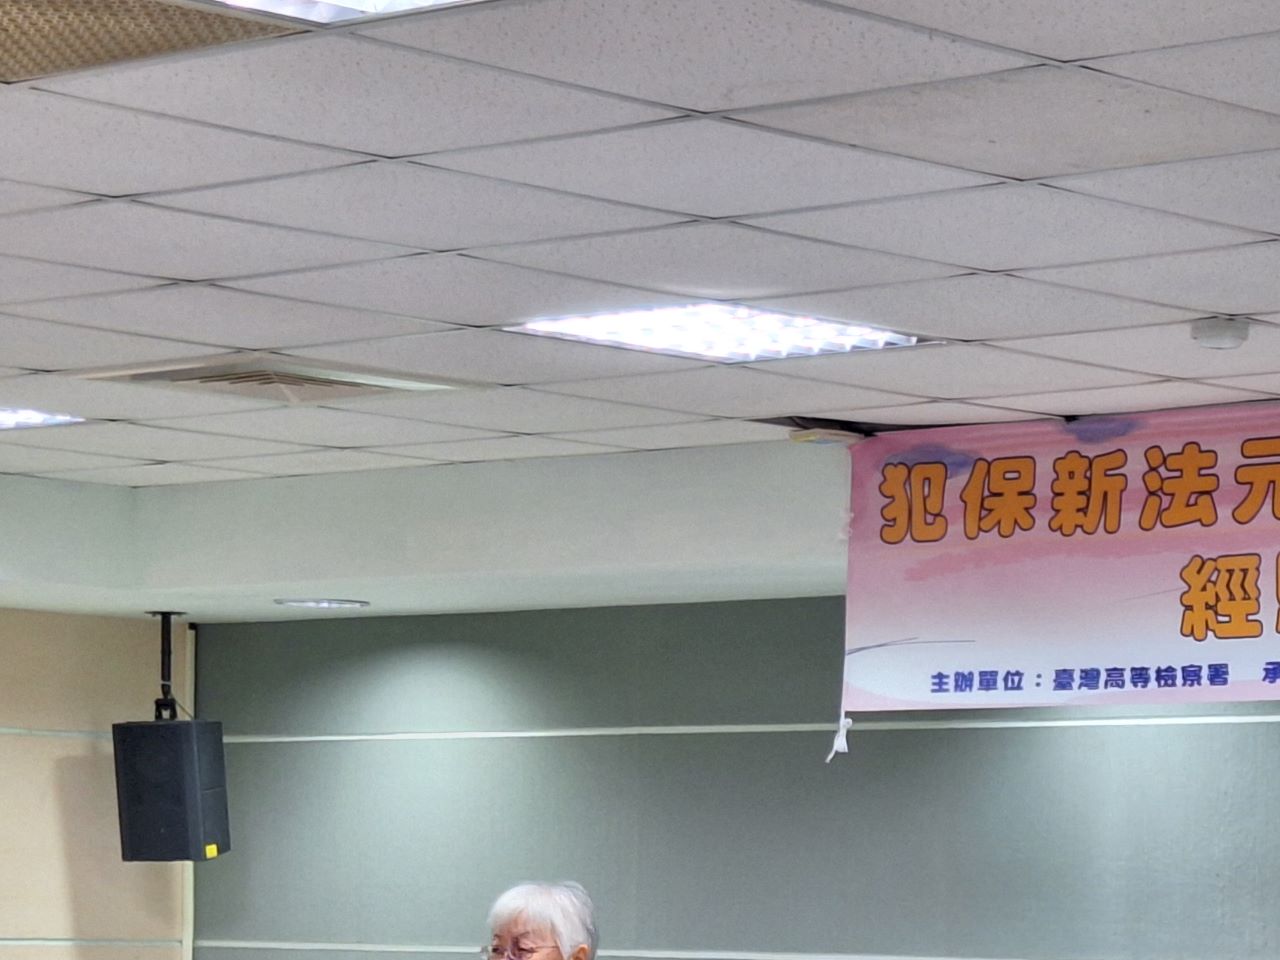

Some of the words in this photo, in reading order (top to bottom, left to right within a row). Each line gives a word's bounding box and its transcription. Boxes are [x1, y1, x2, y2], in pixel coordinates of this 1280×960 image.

[930, 662, 1230, 694] 主辦單位：臺灣高等檢察署
